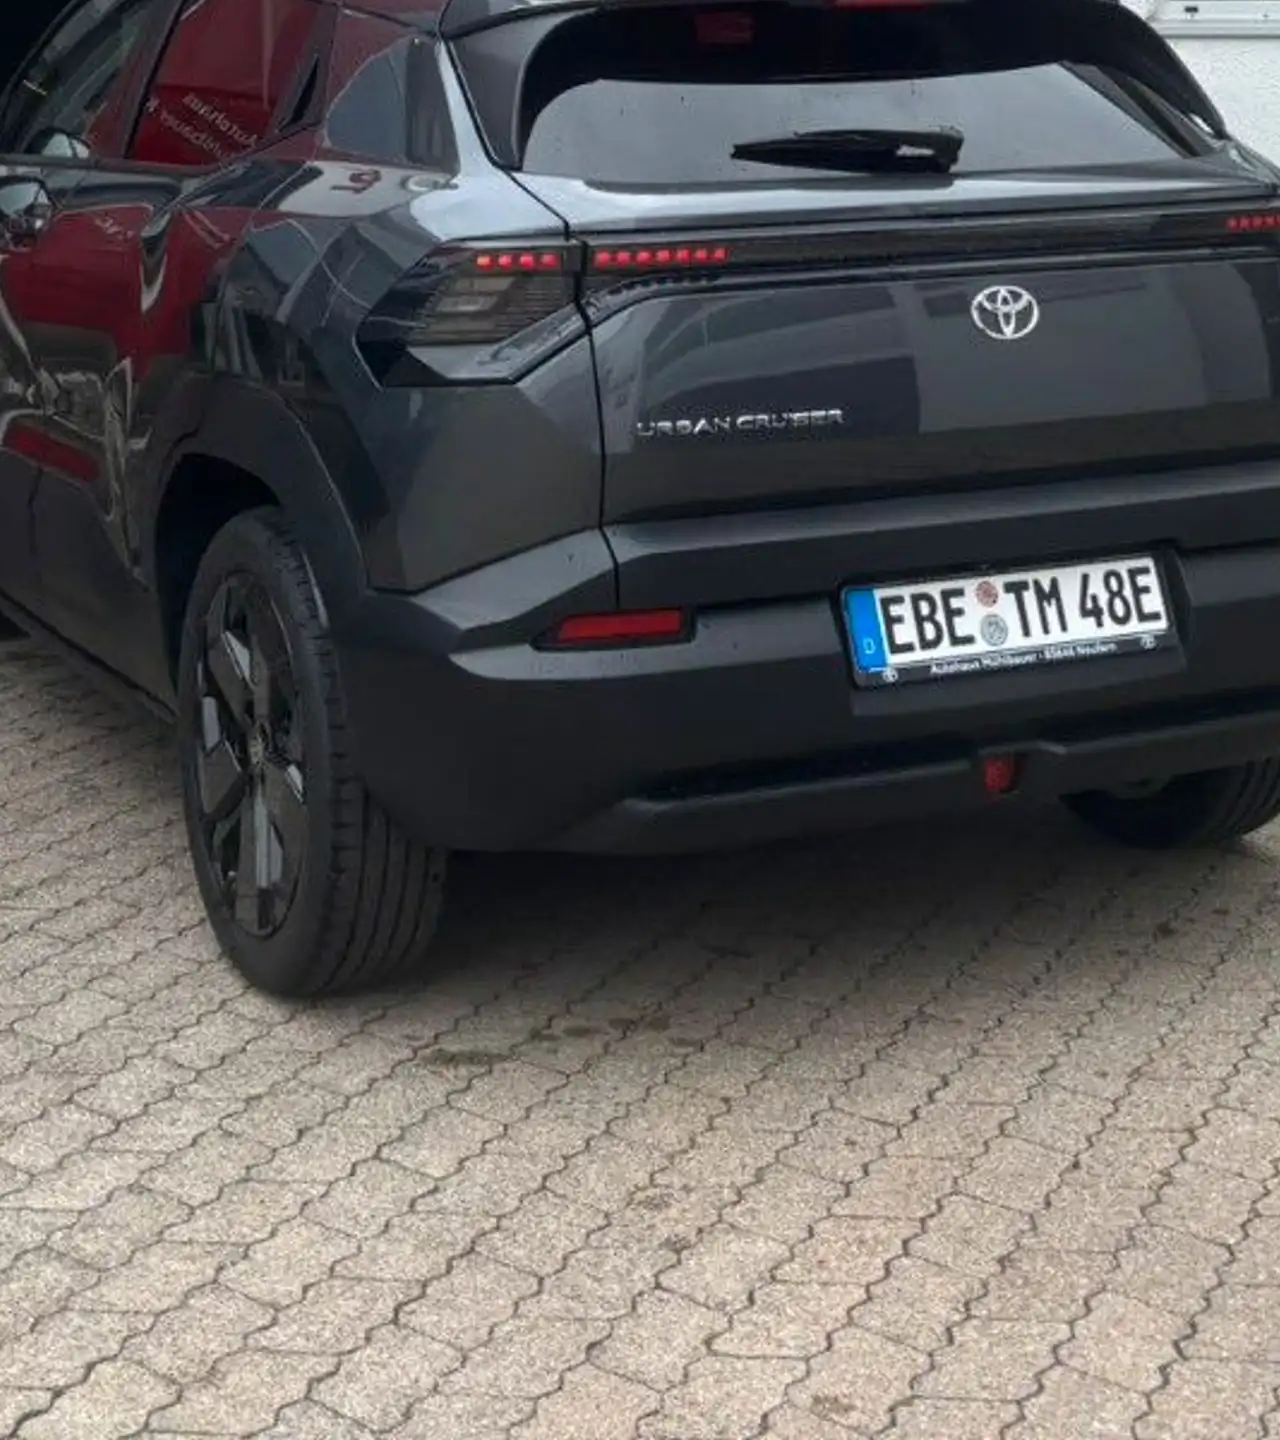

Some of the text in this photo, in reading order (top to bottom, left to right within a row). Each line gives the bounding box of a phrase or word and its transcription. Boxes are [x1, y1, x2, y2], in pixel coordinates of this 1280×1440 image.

[636, 417, 731, 437] URBAN
[879, 566, 1163, 655] EBE TM 48E
